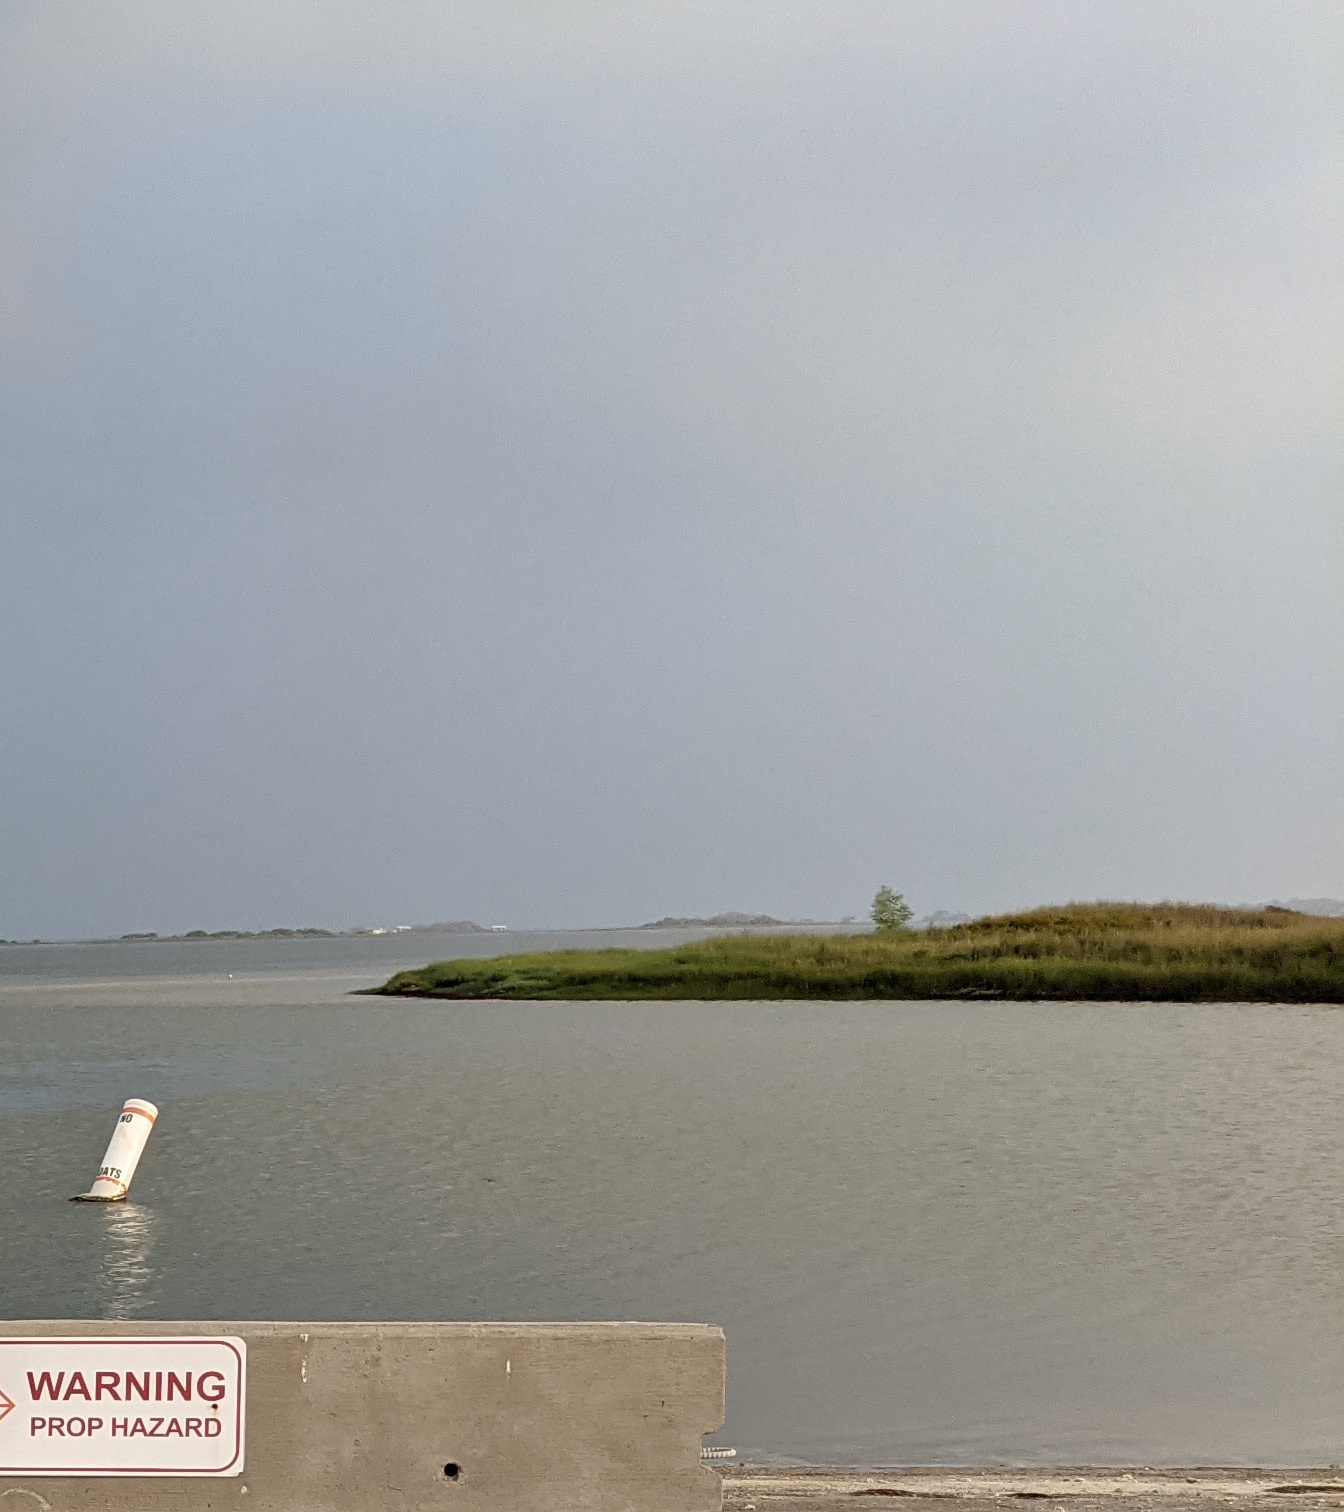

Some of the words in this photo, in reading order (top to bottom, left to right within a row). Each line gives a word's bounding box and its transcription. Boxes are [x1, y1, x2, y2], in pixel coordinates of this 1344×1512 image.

[119, 1113, 133, 1123] NO
[26, 1371, 226, 1402] WARNING
[30, 1416, 103, 1437] PROP
[111, 1417, 222, 1438] HAZARD
